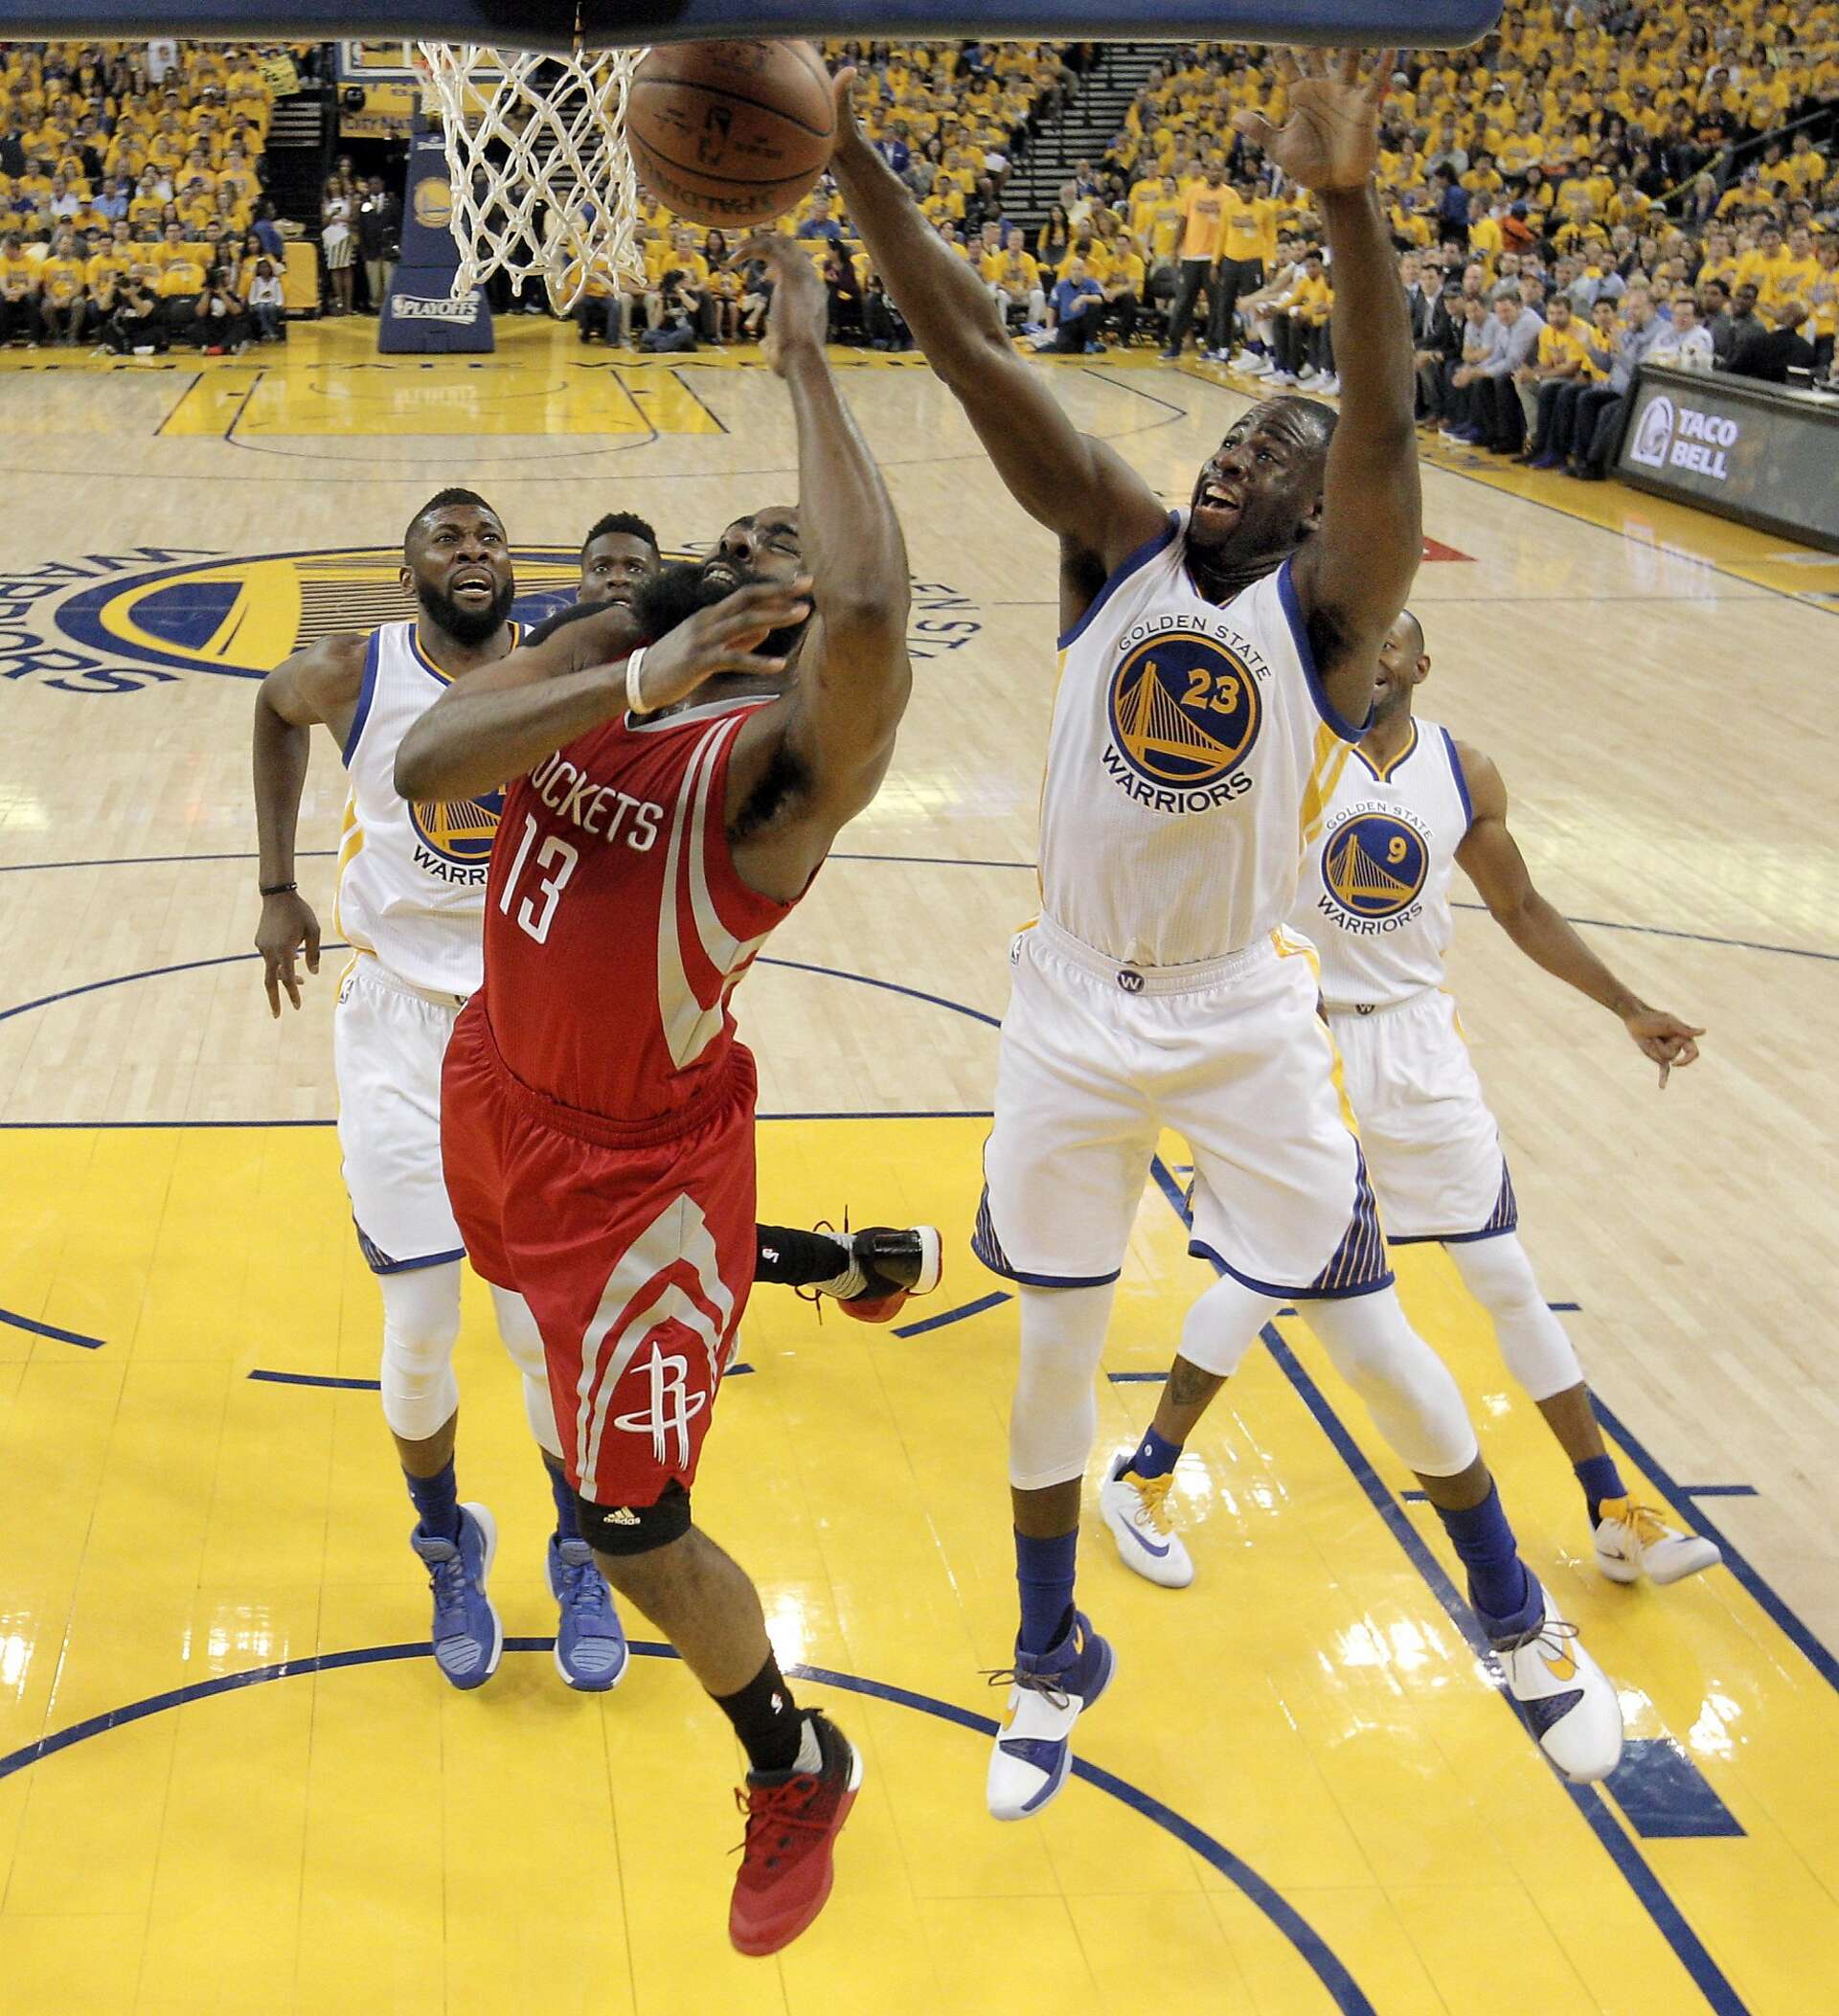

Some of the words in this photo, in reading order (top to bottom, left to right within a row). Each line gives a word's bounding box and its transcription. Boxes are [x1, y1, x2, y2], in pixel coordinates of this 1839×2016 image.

[402, 301, 478, 315] PLAYOFFS
[1678, 407, 1739, 448] TACO
[1669, 440, 1728, 481] BELL
[0, 547, 232, 693] WARRS
[1119, 615, 1207, 651] GOLDEN
[1215, 625, 1271, 681] STATE
[1180, 668, 1240, 714] 23
[1101, 743, 1254, 814] WARRIORS
[528, 750, 665, 852] OCKETS
[1326, 802, 1387, 831] GOLDEN
[1394, 806, 1433, 840] STATE
[413, 844, 489, 886] WARR
[1387, 836, 1408, 865] 9
[499, 812, 579, 945] 13
[1317, 894, 1423, 936] WARRIORS
